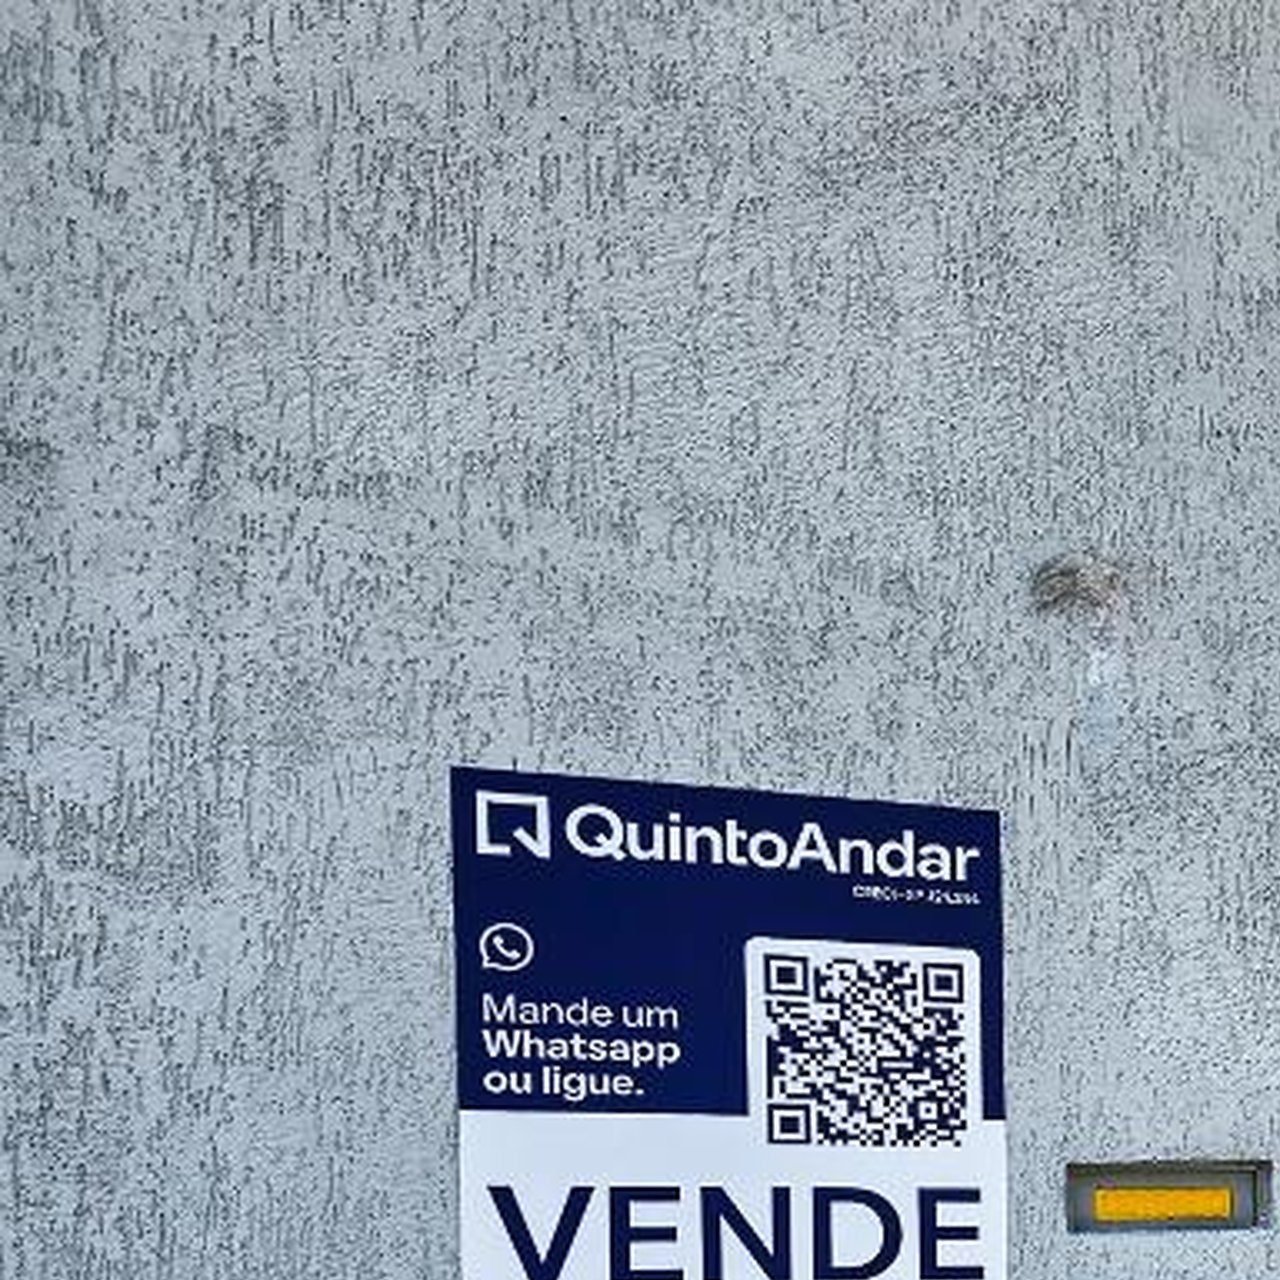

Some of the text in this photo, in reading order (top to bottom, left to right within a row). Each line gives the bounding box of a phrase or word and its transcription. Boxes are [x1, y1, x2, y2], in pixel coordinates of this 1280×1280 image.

[565, 803, 981, 882] QuintoAndar
[482, 993, 679, 1030] Mande um
[481, 1029, 682, 1070] Whatsapp
[482, 1065, 644, 1102] ou ligue.
